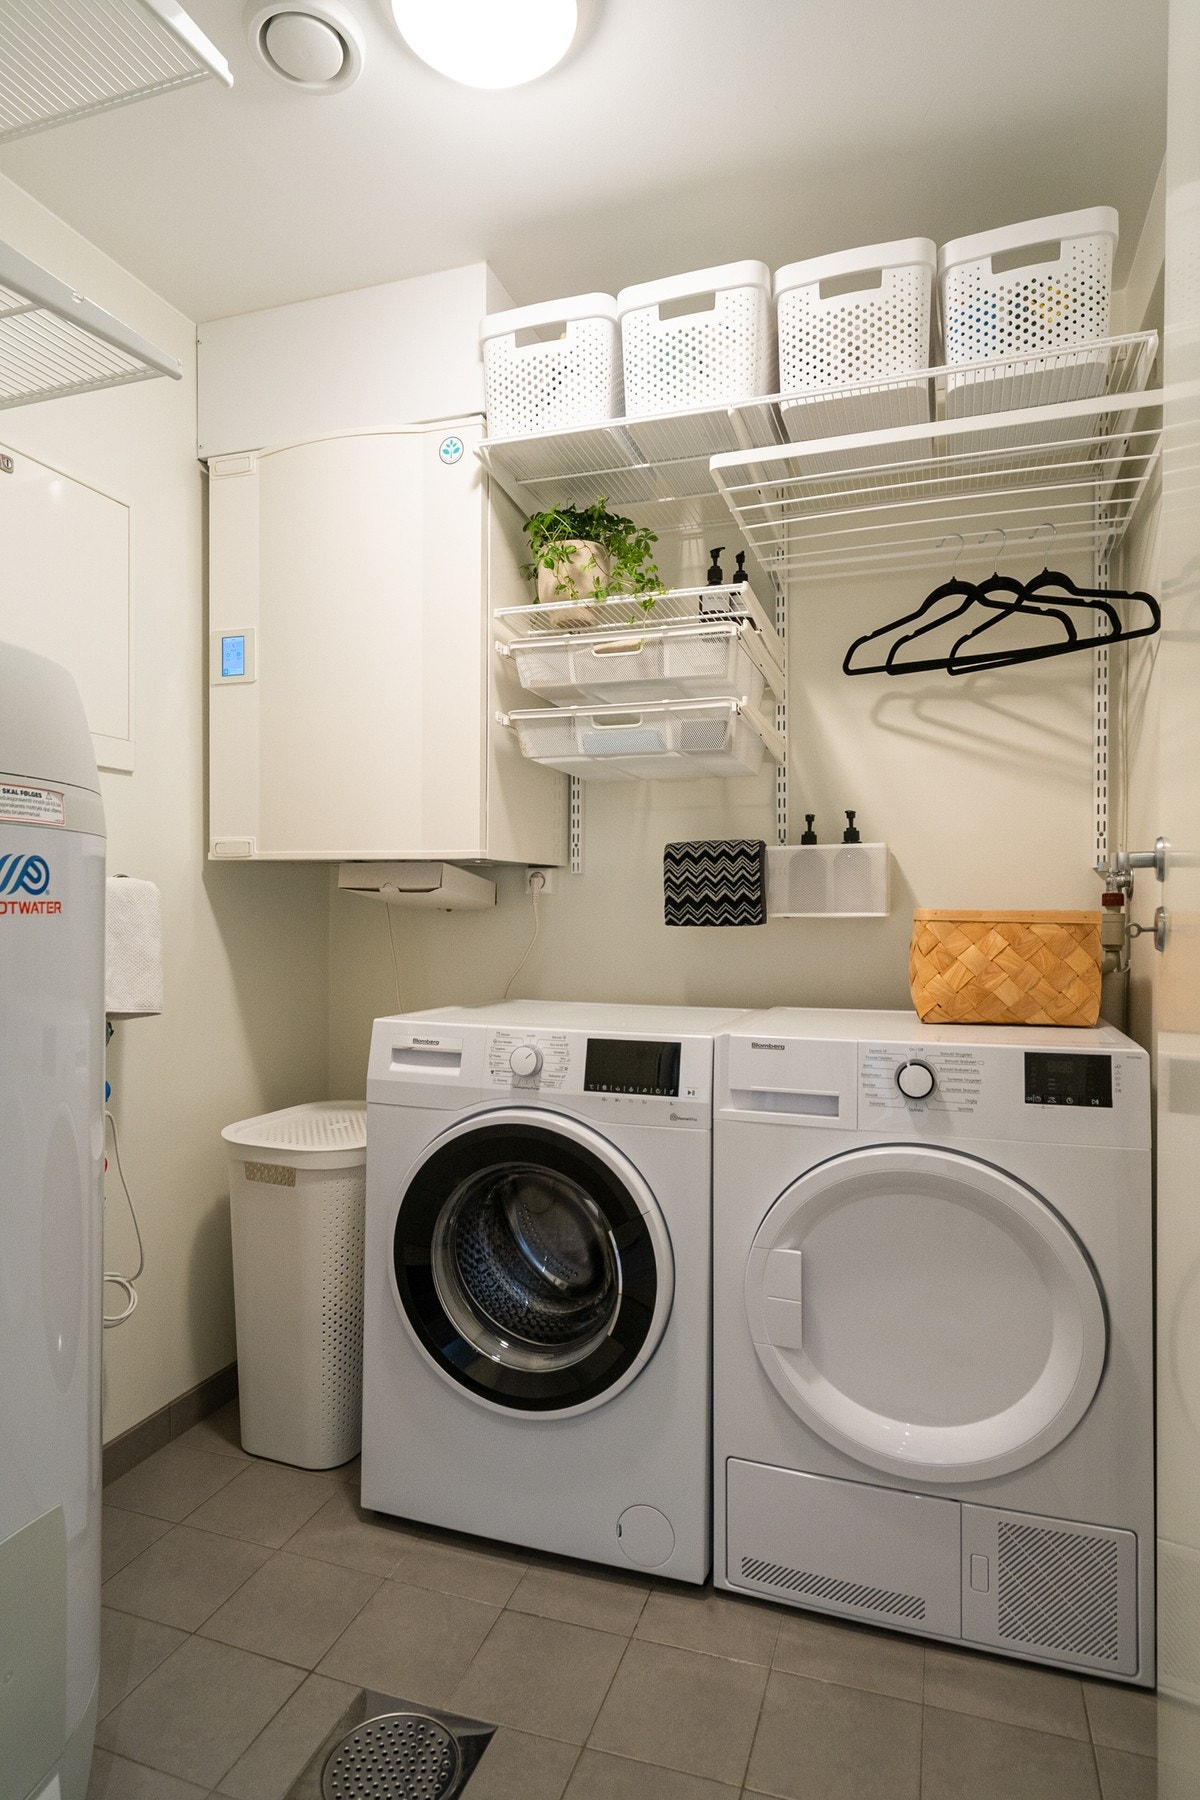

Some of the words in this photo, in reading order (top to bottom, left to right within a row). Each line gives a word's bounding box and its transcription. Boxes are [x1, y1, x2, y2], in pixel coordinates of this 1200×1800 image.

[2, 788, 19, 796] SKAL
[413, 1038, 440, 1046] Blomberg
[751, 1042, 785, 1050] Blomberg
